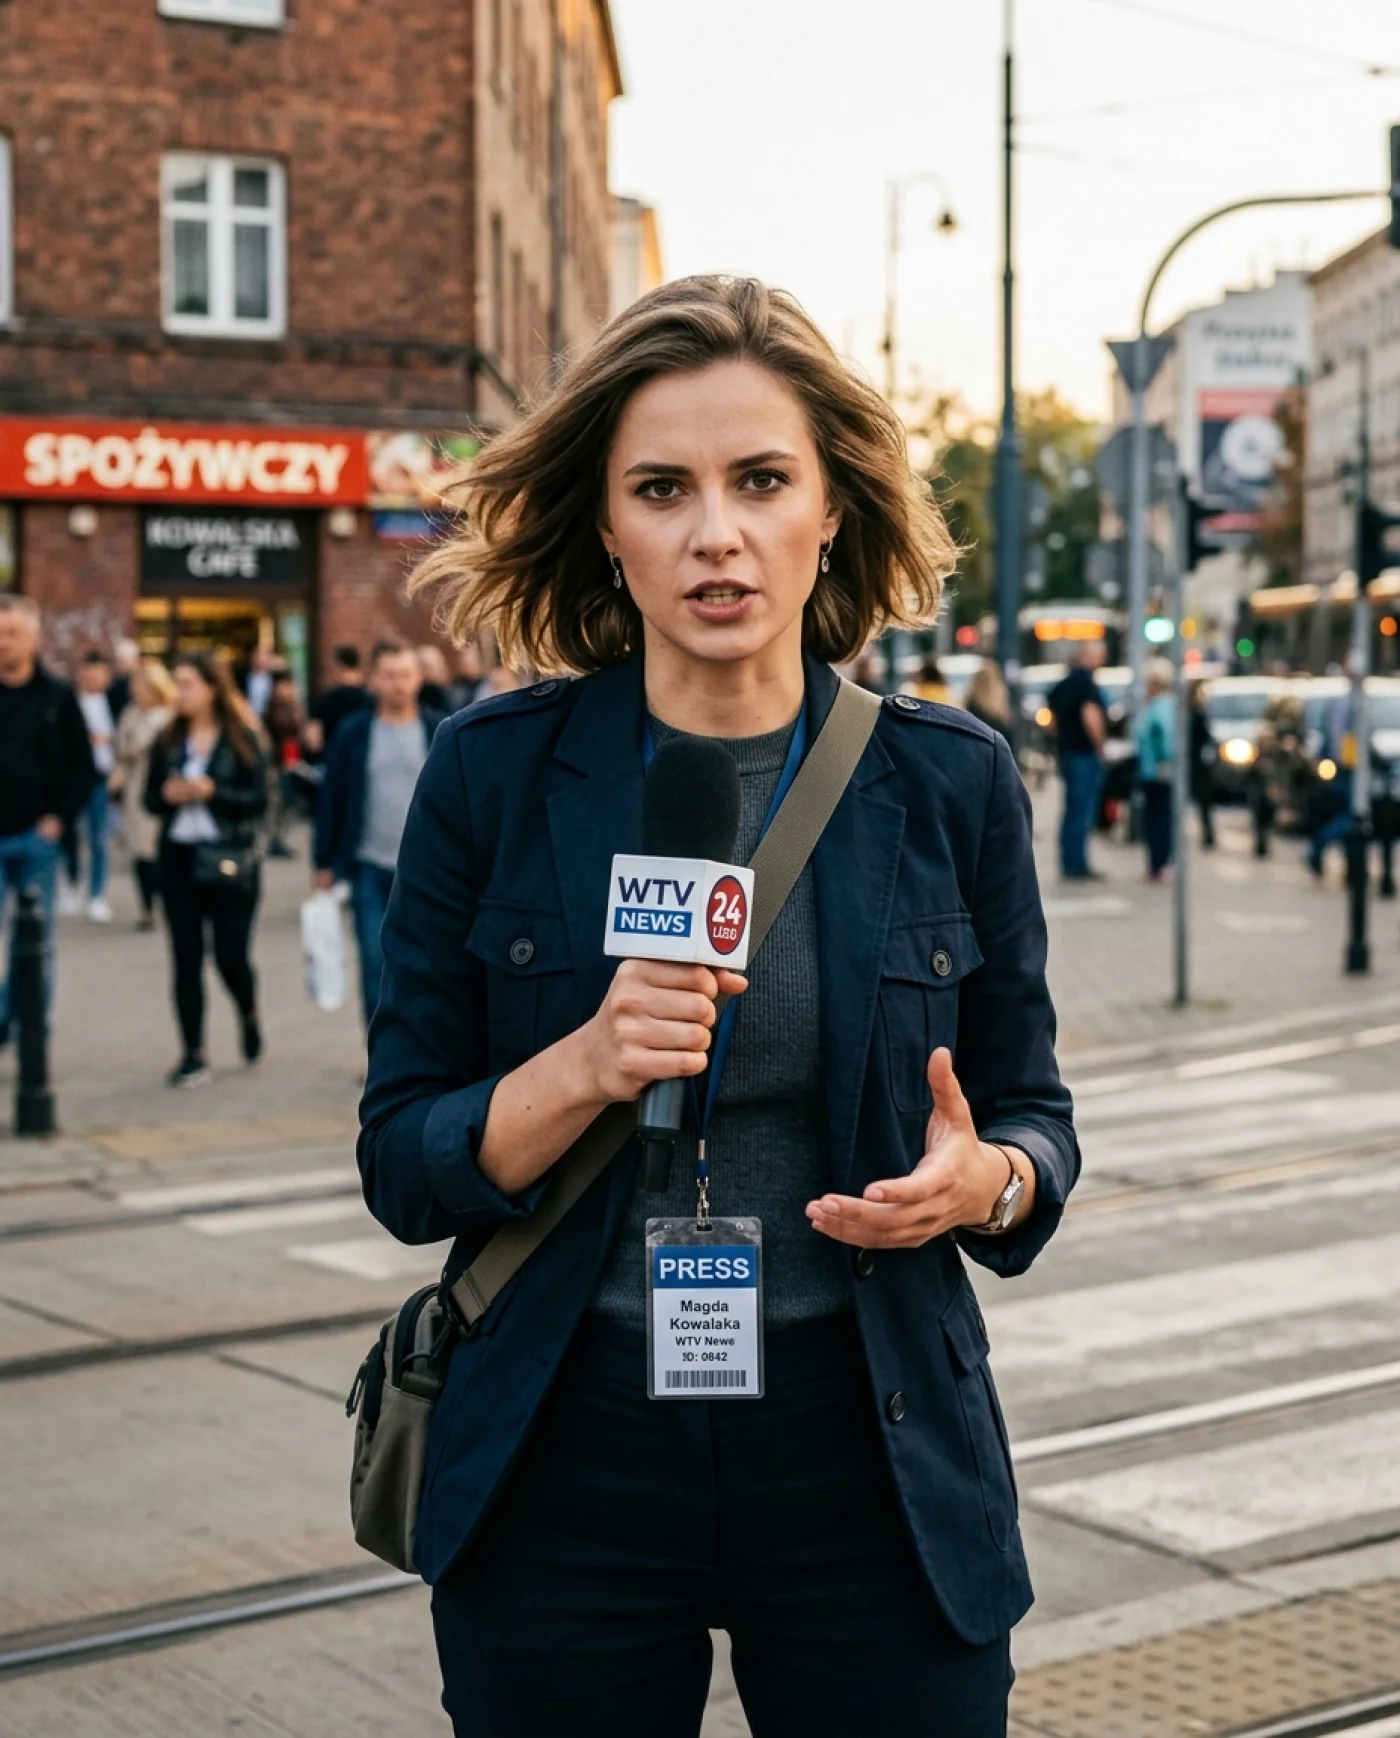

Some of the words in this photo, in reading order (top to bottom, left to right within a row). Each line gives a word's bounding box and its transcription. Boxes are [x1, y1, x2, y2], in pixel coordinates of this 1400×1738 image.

[24, 426, 349, 495] SPOŻYWCZY
[618, 876, 696, 907] WTV
[711, 891, 742, 926] 24
[620, 910, 686, 933] NEWS
[659, 1257, 750, 1280] PRESS
[680, 1300, 730, 1315] Magda
[675, 1336, 702, 1346] WTV
